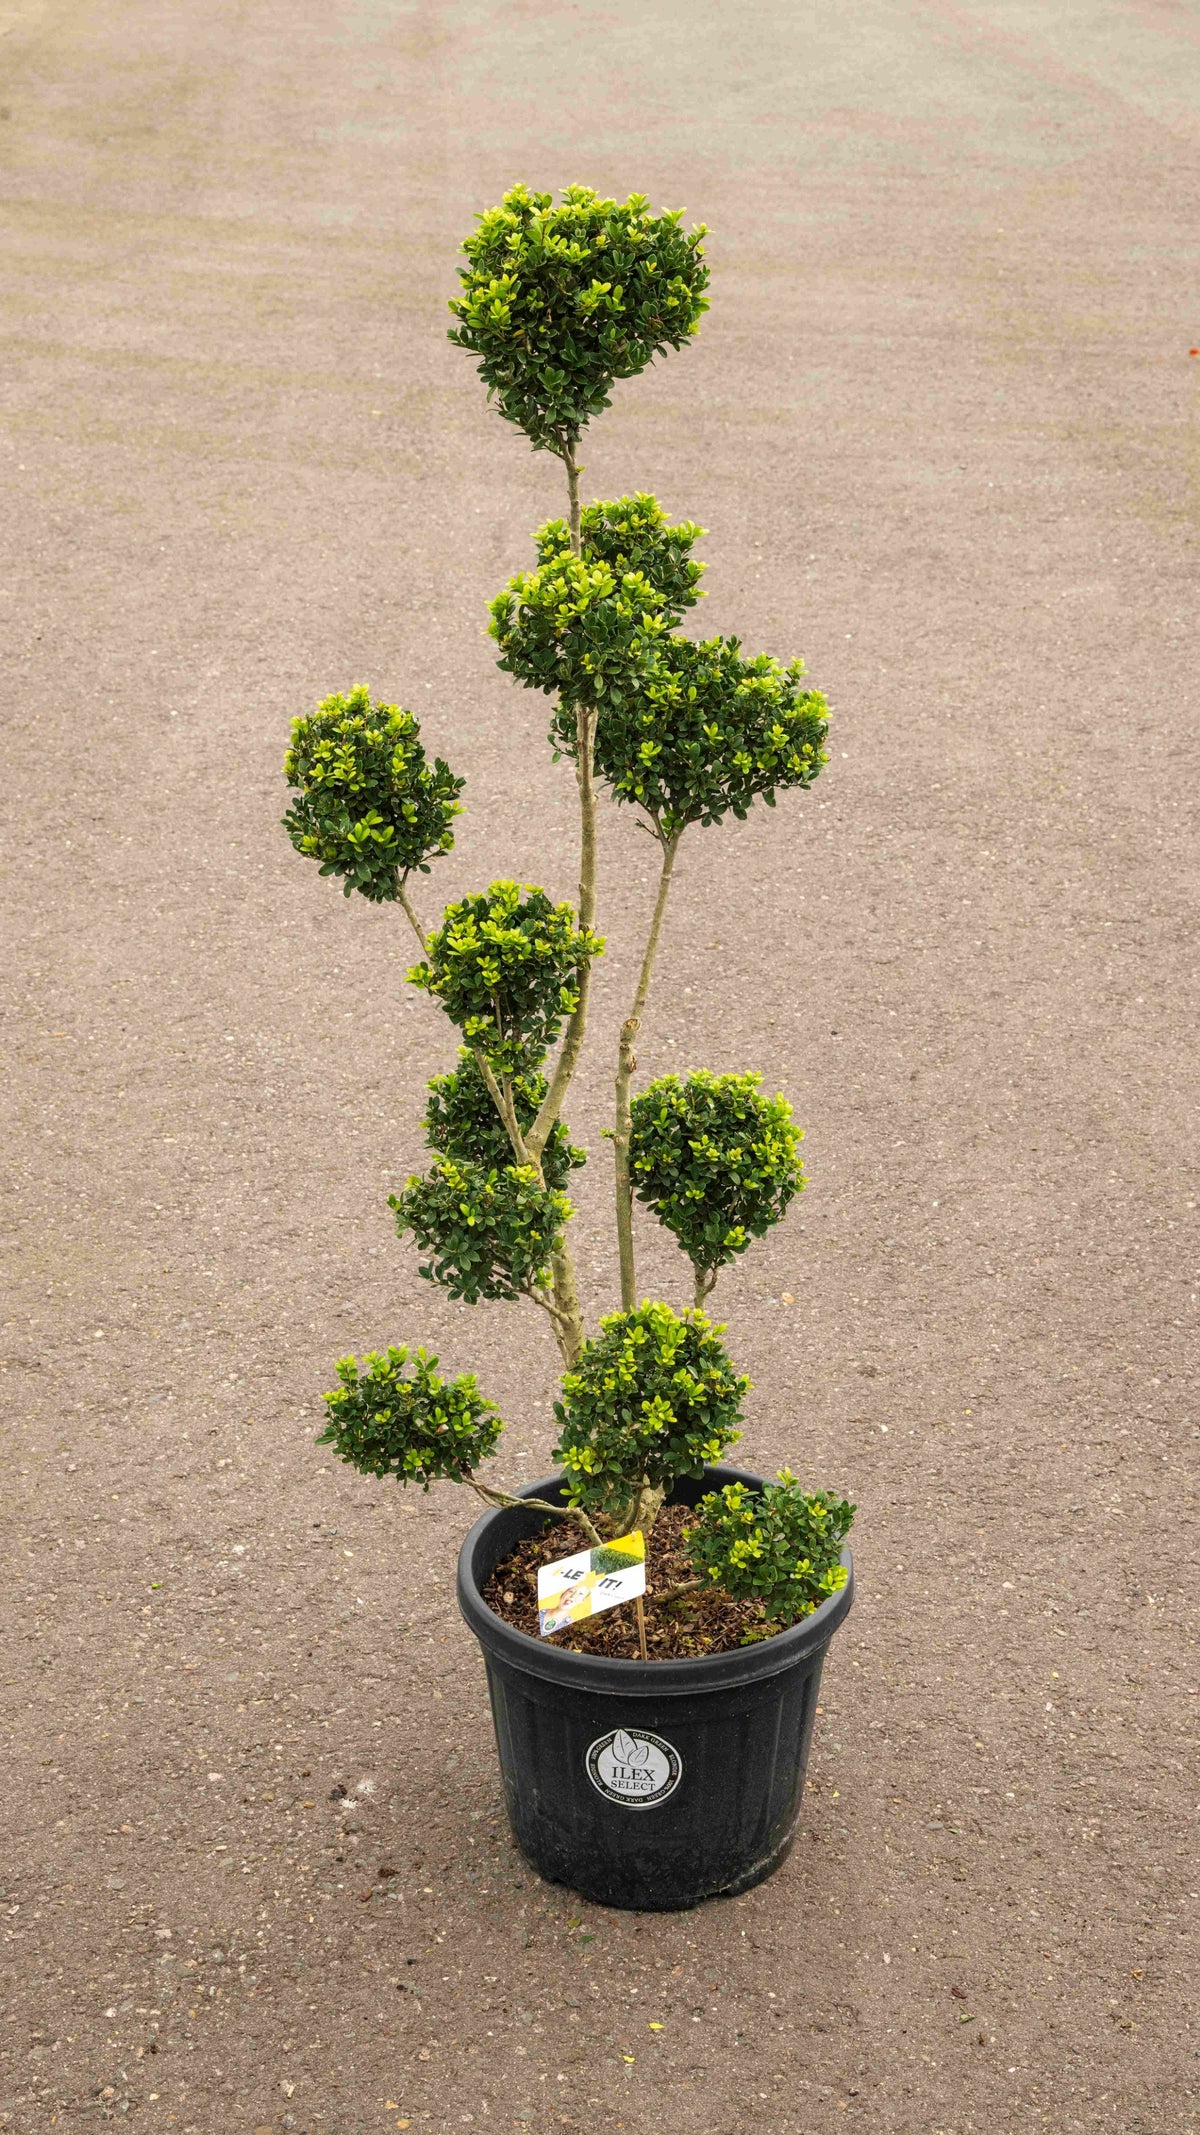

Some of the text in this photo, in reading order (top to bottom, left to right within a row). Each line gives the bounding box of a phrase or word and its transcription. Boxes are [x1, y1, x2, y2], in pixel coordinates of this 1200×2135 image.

[598, 1578, 623, 1590] IT!
[632, 1732, 669, 1752] DARK GREEN
[611, 1766, 656, 1782] ILEX
[610, 1780, 656, 1791] SELECT
[604, 1789, 625, 1801] GREEN
